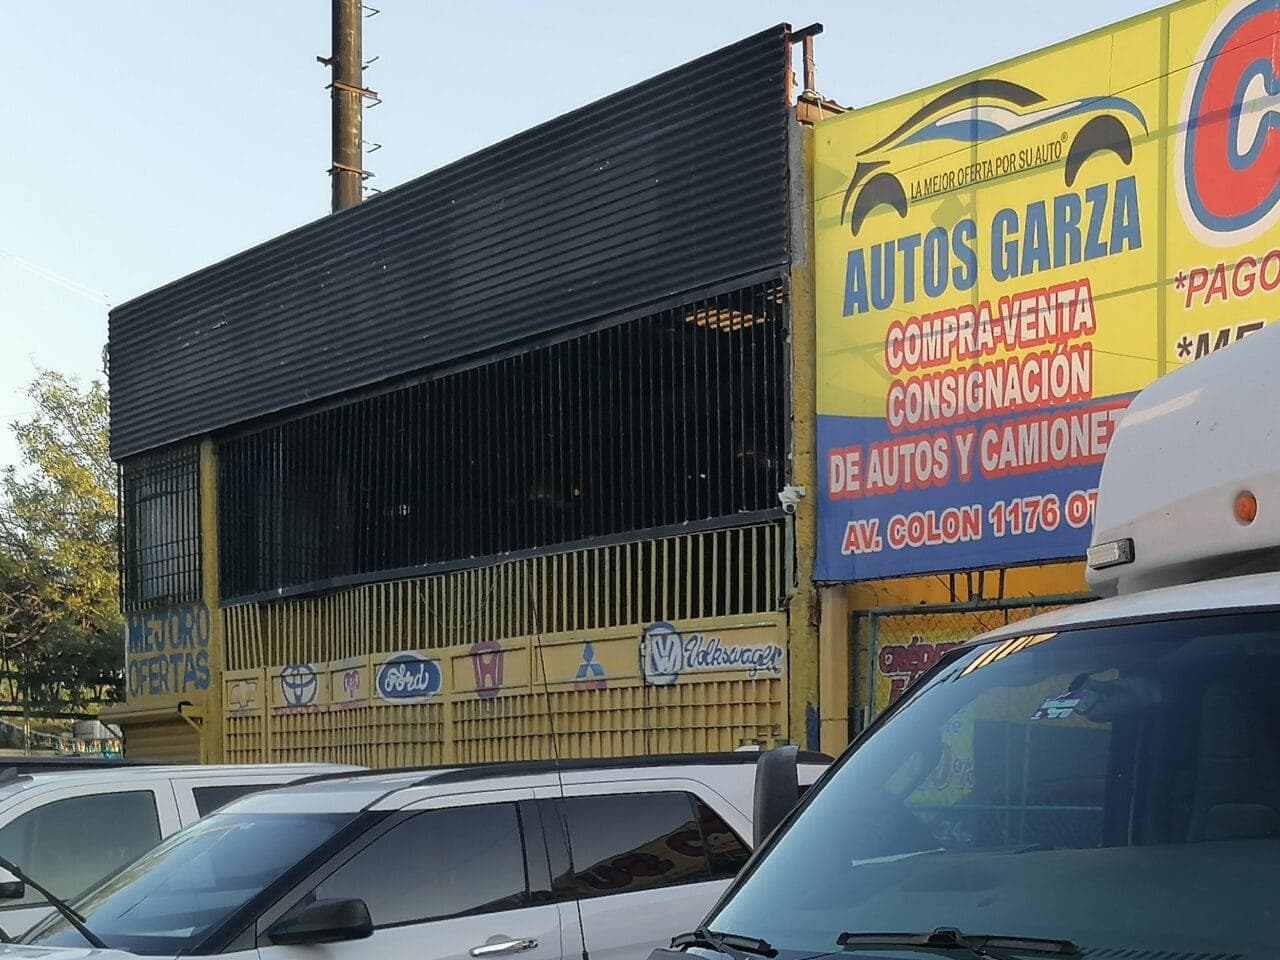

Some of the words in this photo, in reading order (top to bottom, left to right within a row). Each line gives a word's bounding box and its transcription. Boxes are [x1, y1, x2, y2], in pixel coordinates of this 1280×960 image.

[911, 180, 922, 200] LA
[924, 171, 956, 196] MEJOR
[957, 159, 994, 186] OFERTA
[995, 153, 1017, 176] POR
[1018, 147, 1034, 169] SU
[843, 217, 978, 317] AUTOS
[990, 174, 1143, 283] GARZA
[886, 283, 1095, 369] COMPRA-VENTA
[886, 343, 1092, 429] CONSIGNACIÓN
[829, 450, 861, 494] DE
[865, 435, 950, 490] AUTOS
[955, 433, 974, 476] Y
[841, 517, 882, 556] AV.
[886, 504, 982, 550] COLON
[988, 493, 1061, 540] 1176
[128, 651, 211, 698] OFERTAS
[384, 663, 430, 693] Ford
